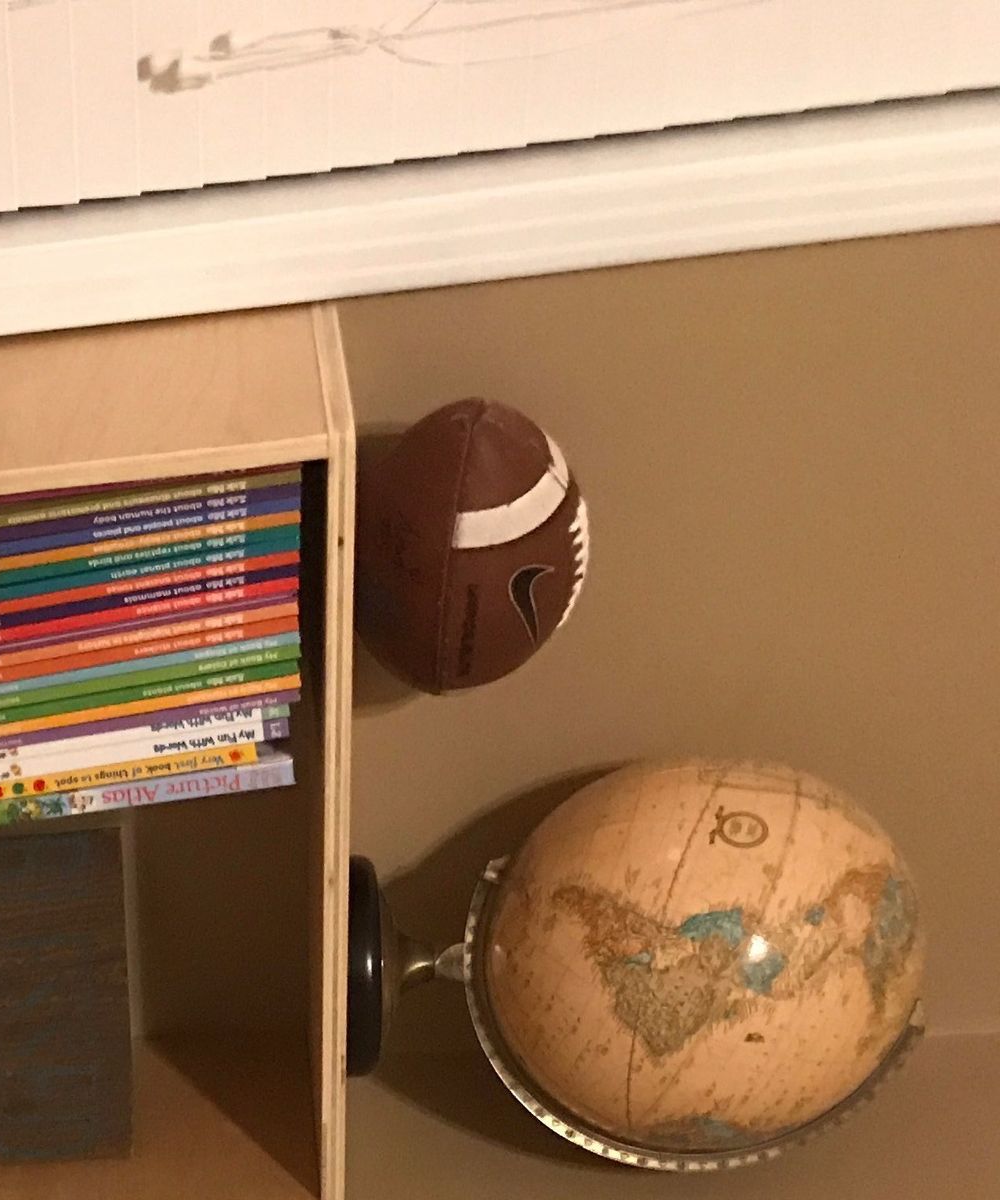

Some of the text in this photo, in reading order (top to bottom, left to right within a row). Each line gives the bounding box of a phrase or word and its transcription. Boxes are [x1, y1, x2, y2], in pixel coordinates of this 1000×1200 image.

[207, 498, 224, 508] Me
[119, 510, 153, 521] human
[154, 507, 171, 515] the
[208, 512, 225, 521] Me
[93, 514, 116, 525] body
[143, 518, 173, 532] people
[93, 526, 121, 539] places
[123, 525, 141, 534] and
[207, 538, 224, 548] Me
[114, 553, 133, 563] and
[135, 547, 171, 560] reptiles
[206, 554, 223, 563] Me
[88, 556, 112, 567] birds
[110, 568, 137, 579] earth
[123, 576, 245, 603] Ask Me about mammals
[153, 729, 255, 753] My Fun With Words
[55, 753, 224, 787] Very first book of things to spot
[102, 774, 241, 807] Picture Atlas
